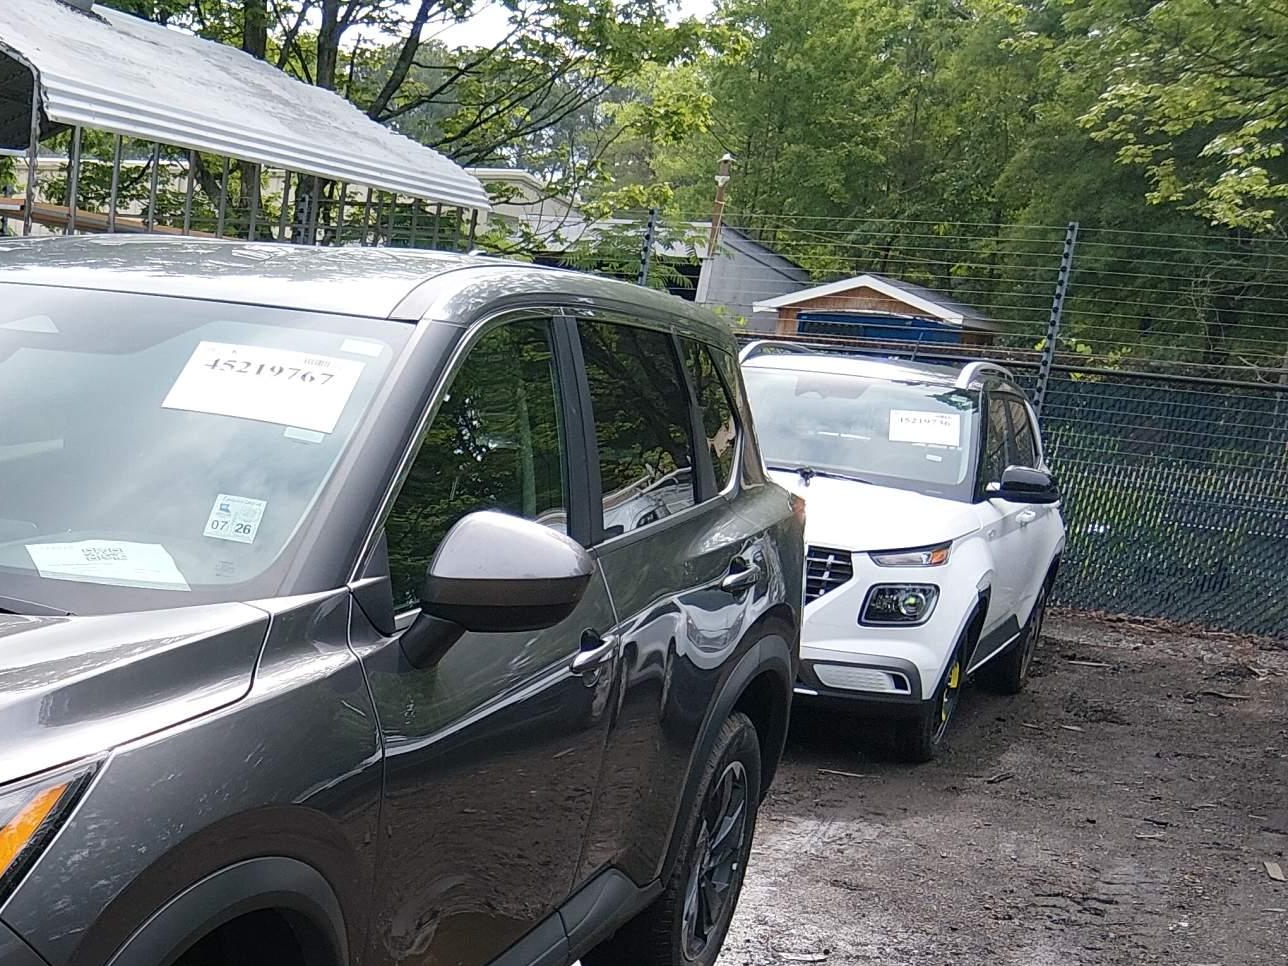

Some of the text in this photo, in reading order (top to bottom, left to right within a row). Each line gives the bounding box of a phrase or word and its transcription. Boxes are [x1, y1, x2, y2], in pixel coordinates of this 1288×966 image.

[203, 358, 335, 385] 45219767
[211, 519, 252, 535] 07 26
